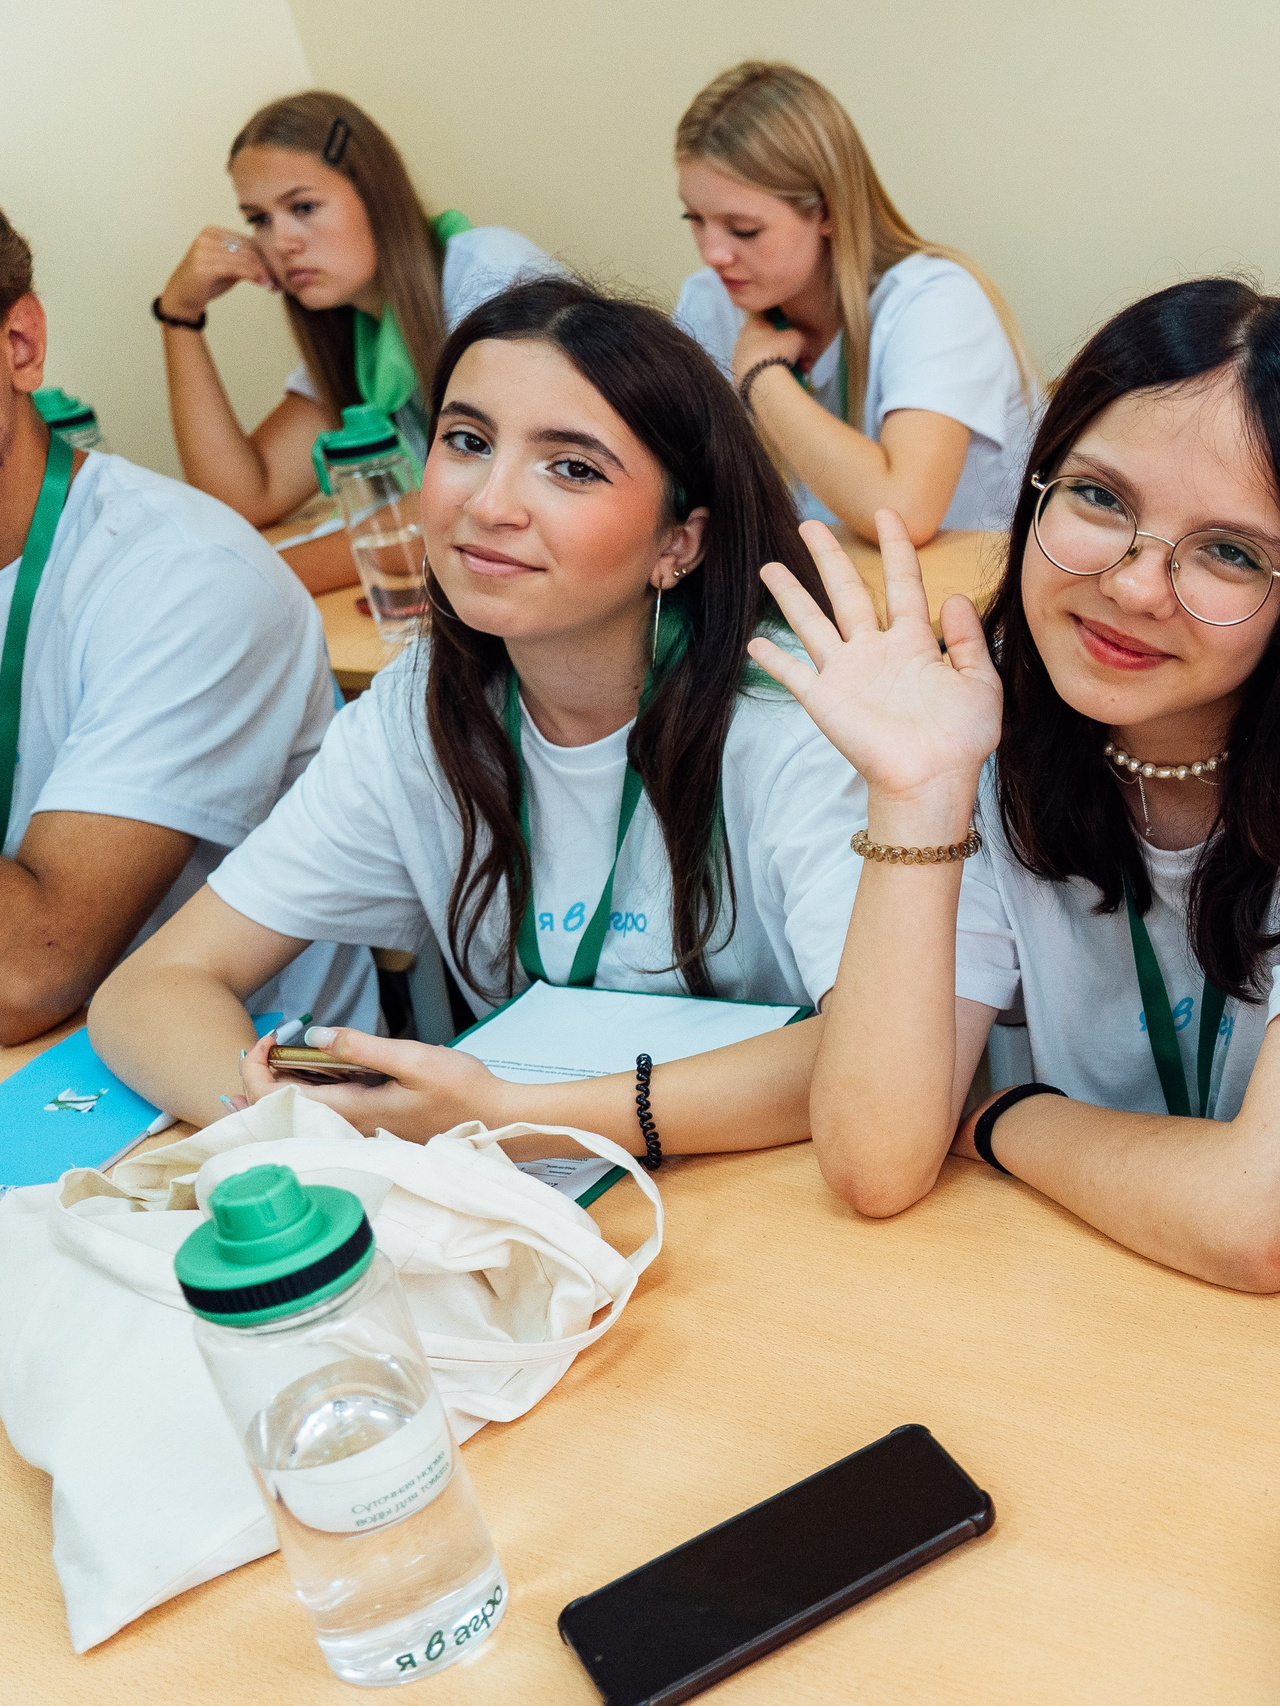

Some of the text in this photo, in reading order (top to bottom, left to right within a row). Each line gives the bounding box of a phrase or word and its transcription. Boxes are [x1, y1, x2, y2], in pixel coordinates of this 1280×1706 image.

[607, 911, 647, 938] гро
[351, 1479, 415, 1514] Суточная
[453, 1585, 503, 1646] агро
